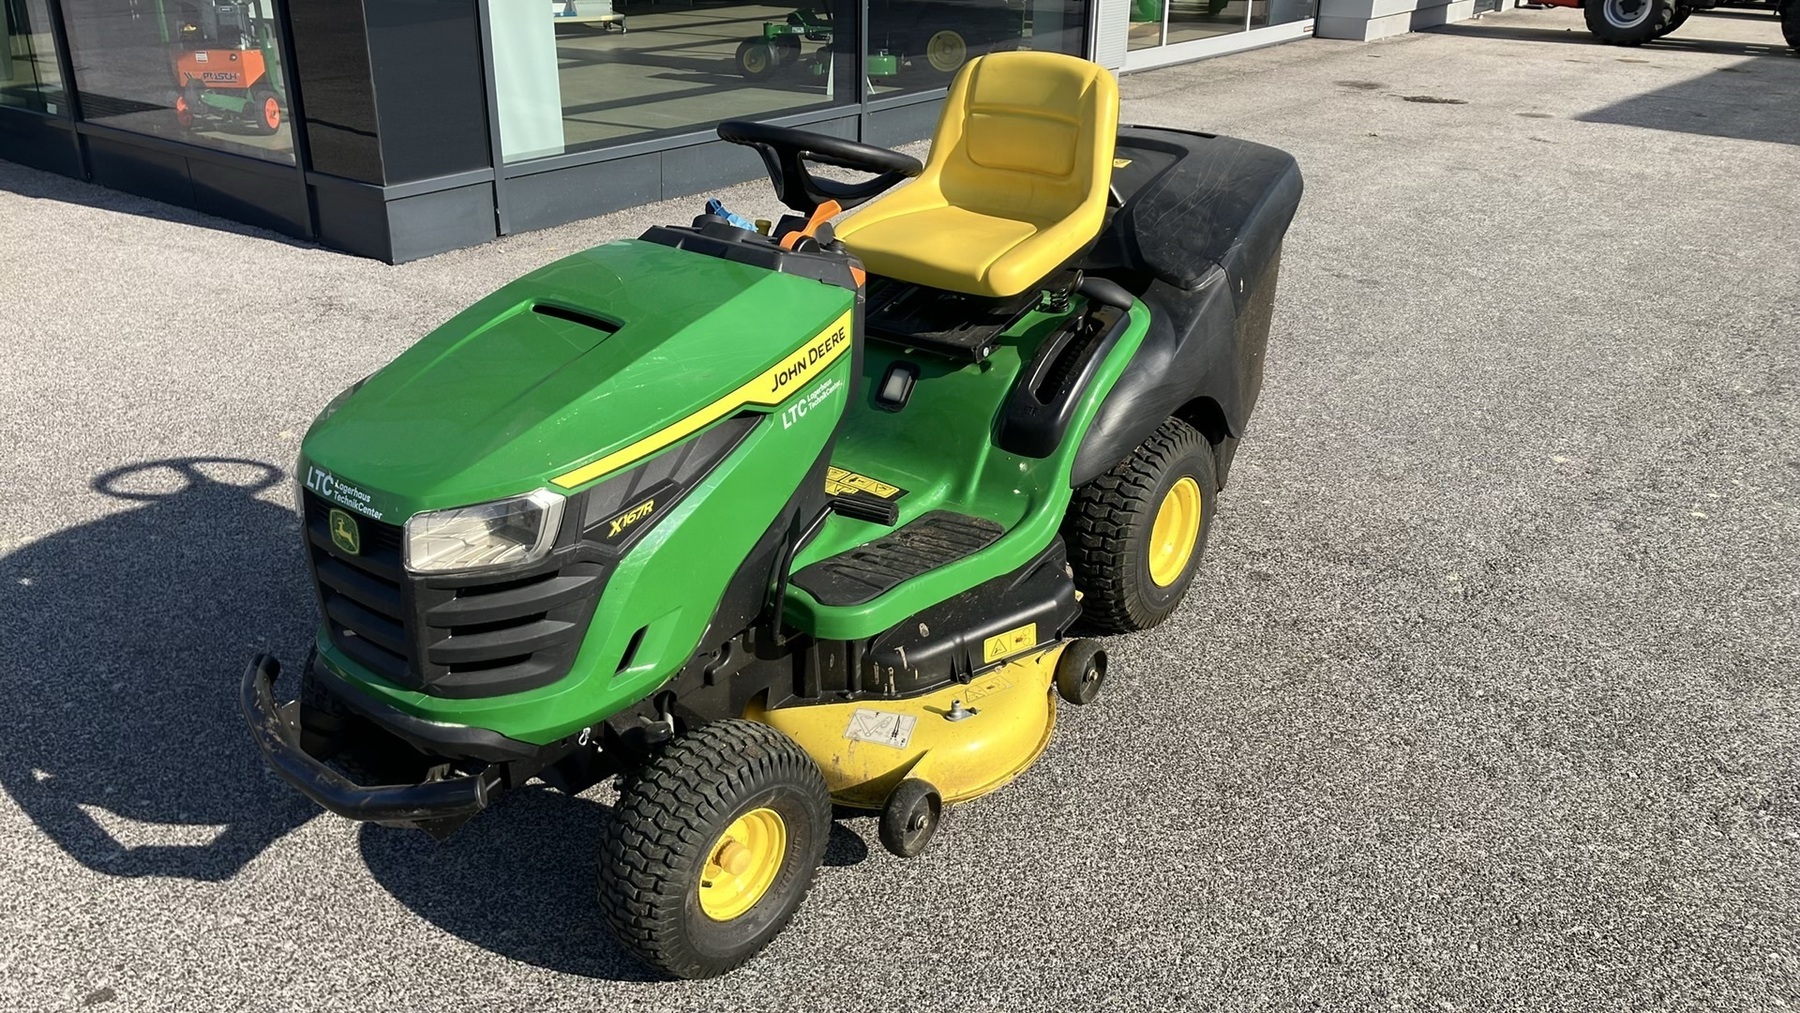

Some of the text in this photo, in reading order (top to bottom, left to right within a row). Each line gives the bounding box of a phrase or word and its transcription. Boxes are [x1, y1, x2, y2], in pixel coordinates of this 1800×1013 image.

[771, 326, 846, 393] JOHN DEERE
[806, 378, 833, 403] Lagerhaus
[782, 398, 808, 430] LTC
[306, 464, 334, 496] LTC
[334, 479, 372, 503] Lagerhaus
[333, 490, 383, 520] TechnikCenter
[607, 499, 655, 539] X167R
